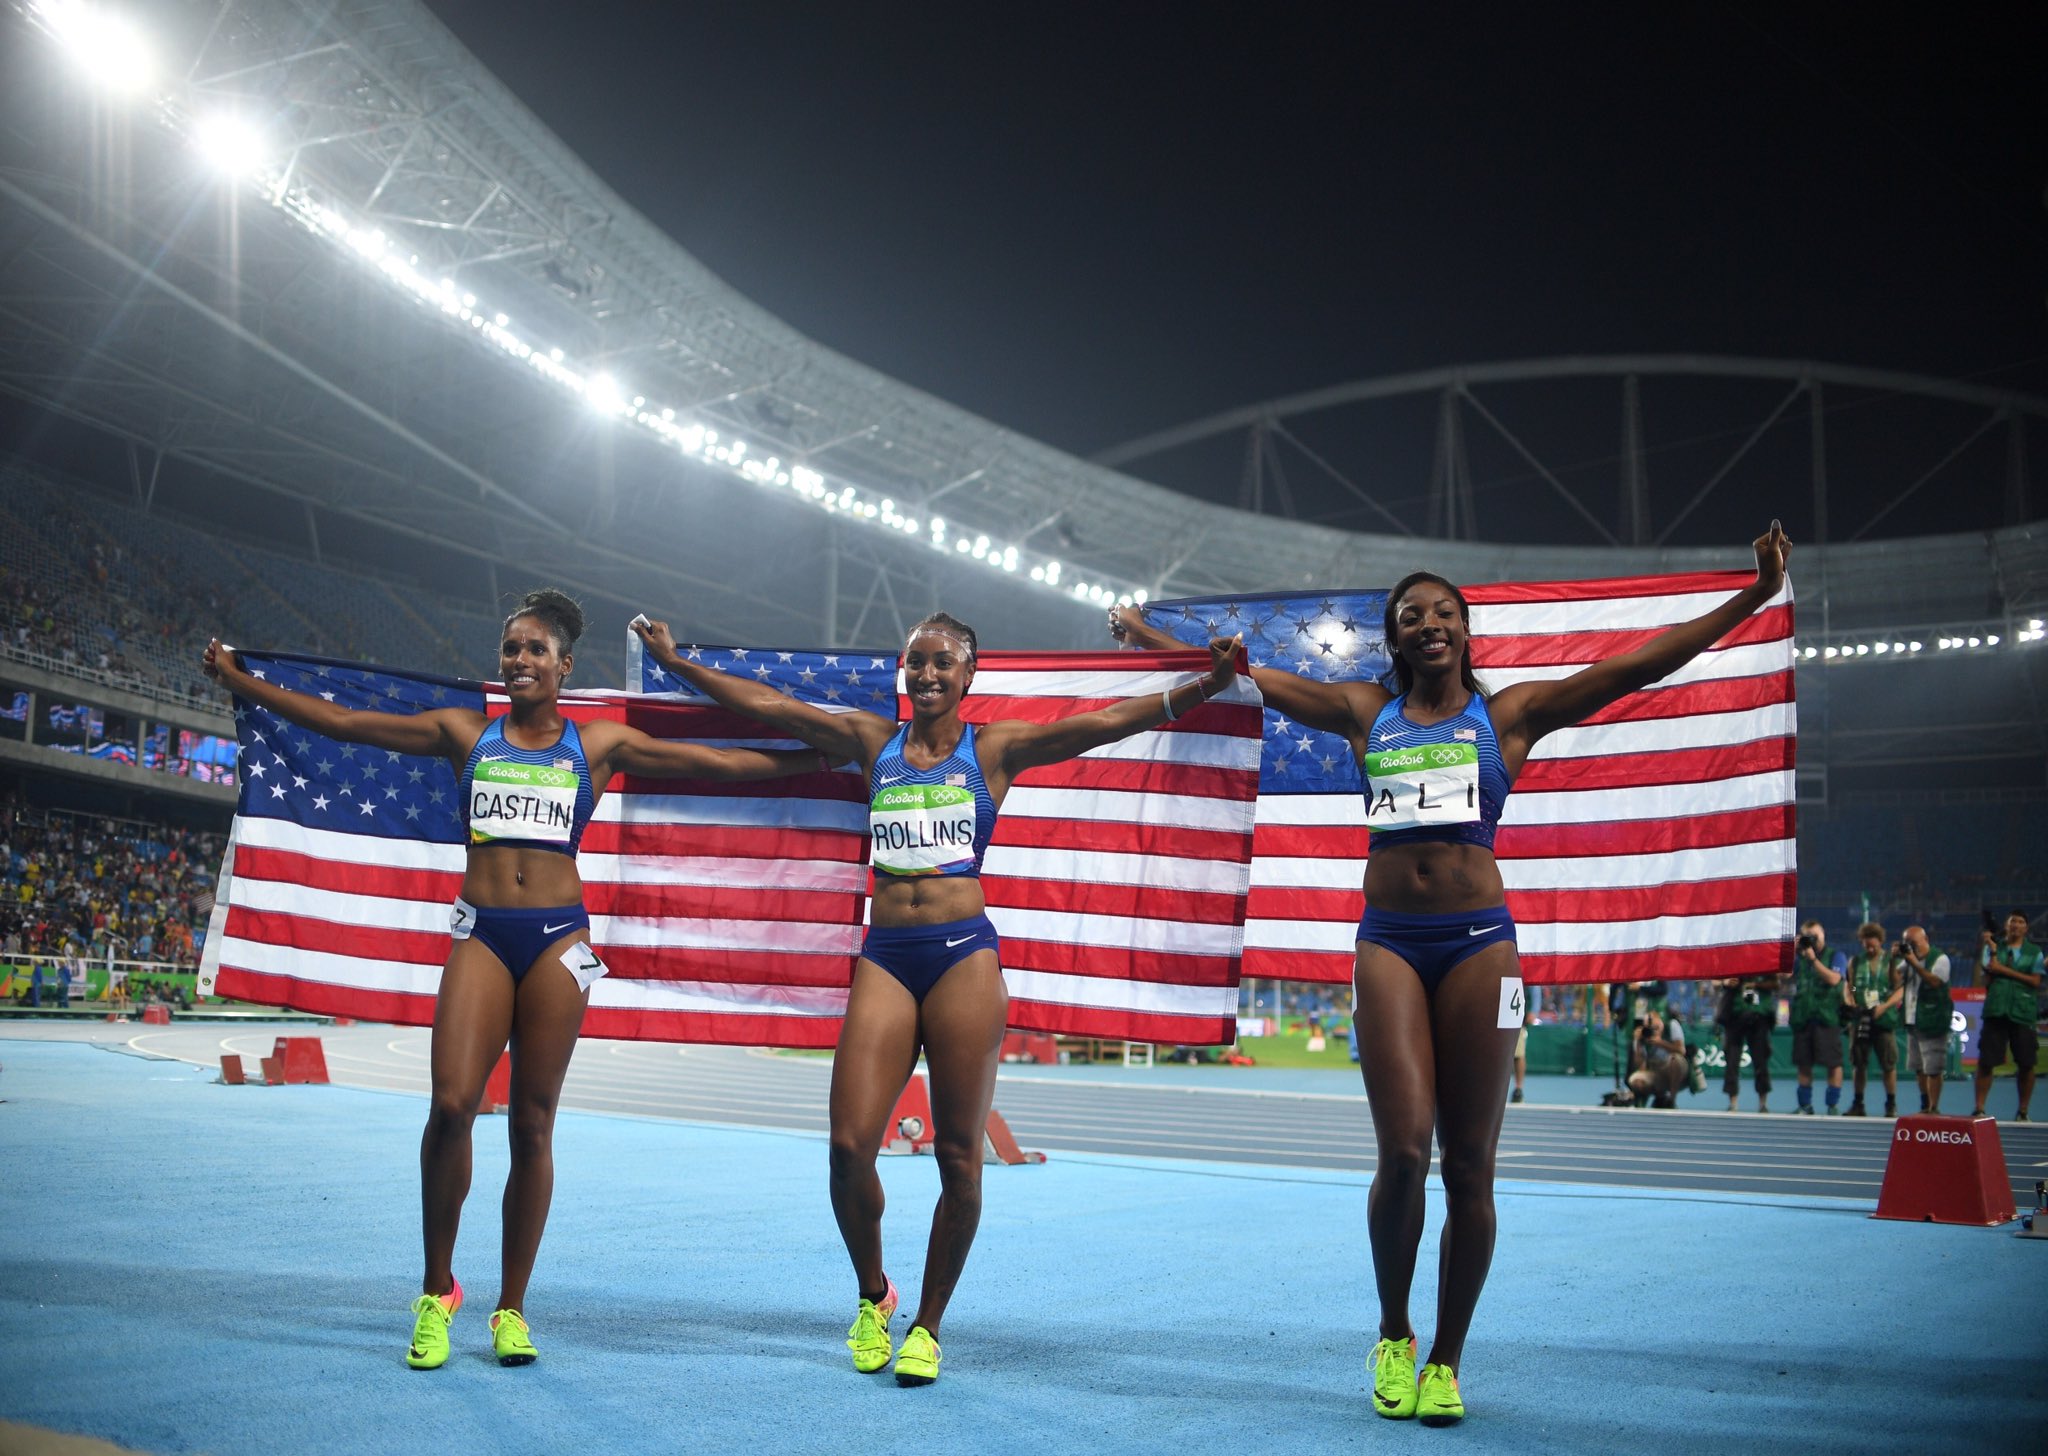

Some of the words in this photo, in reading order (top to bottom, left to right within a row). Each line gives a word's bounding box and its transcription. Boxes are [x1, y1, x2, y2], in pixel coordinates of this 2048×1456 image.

[473, 792, 571, 829] CASTLIN
[873, 819, 972, 851] ROLLINS
[1509, 987, 1521, 1017] 4
[1915, 1129, 1973, 1145] OMEGA
